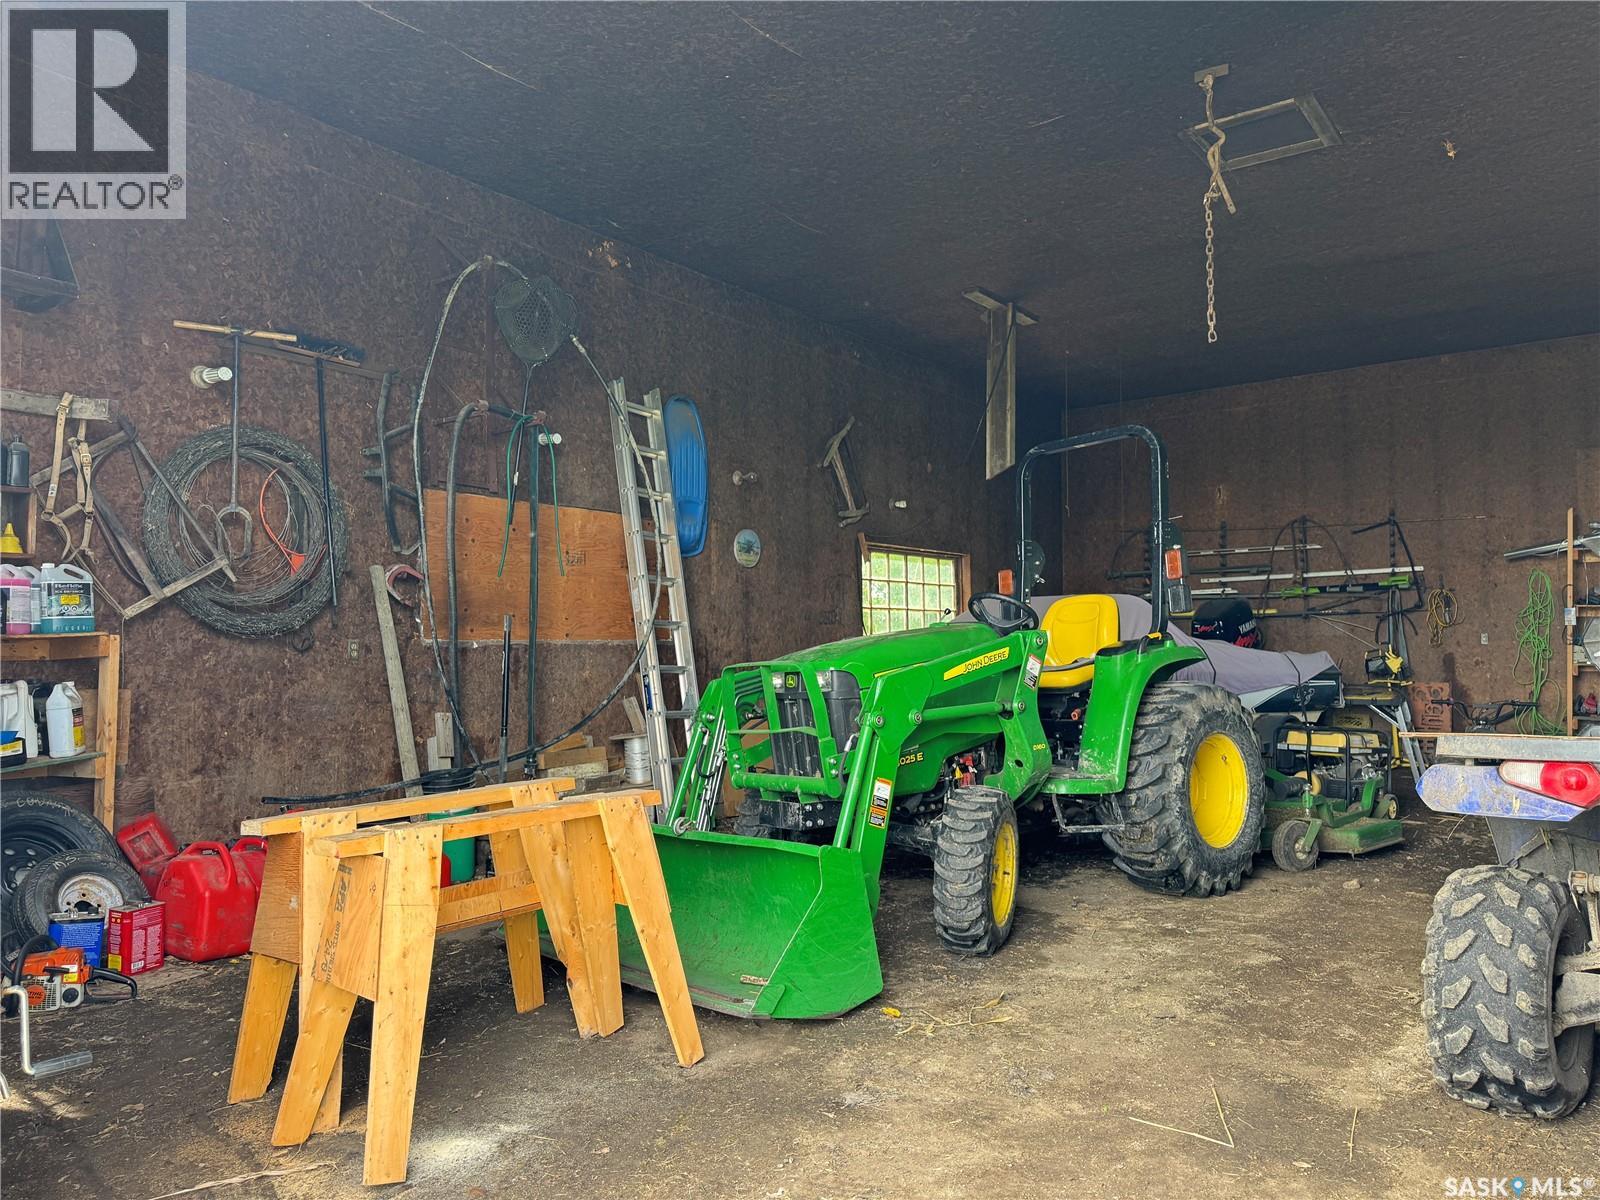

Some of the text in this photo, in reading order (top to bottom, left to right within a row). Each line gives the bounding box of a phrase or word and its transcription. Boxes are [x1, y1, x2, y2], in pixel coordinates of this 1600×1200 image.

[963, 651, 1007, 673] JOHN DEERE
[899, 751, 924, 765] 025 E
